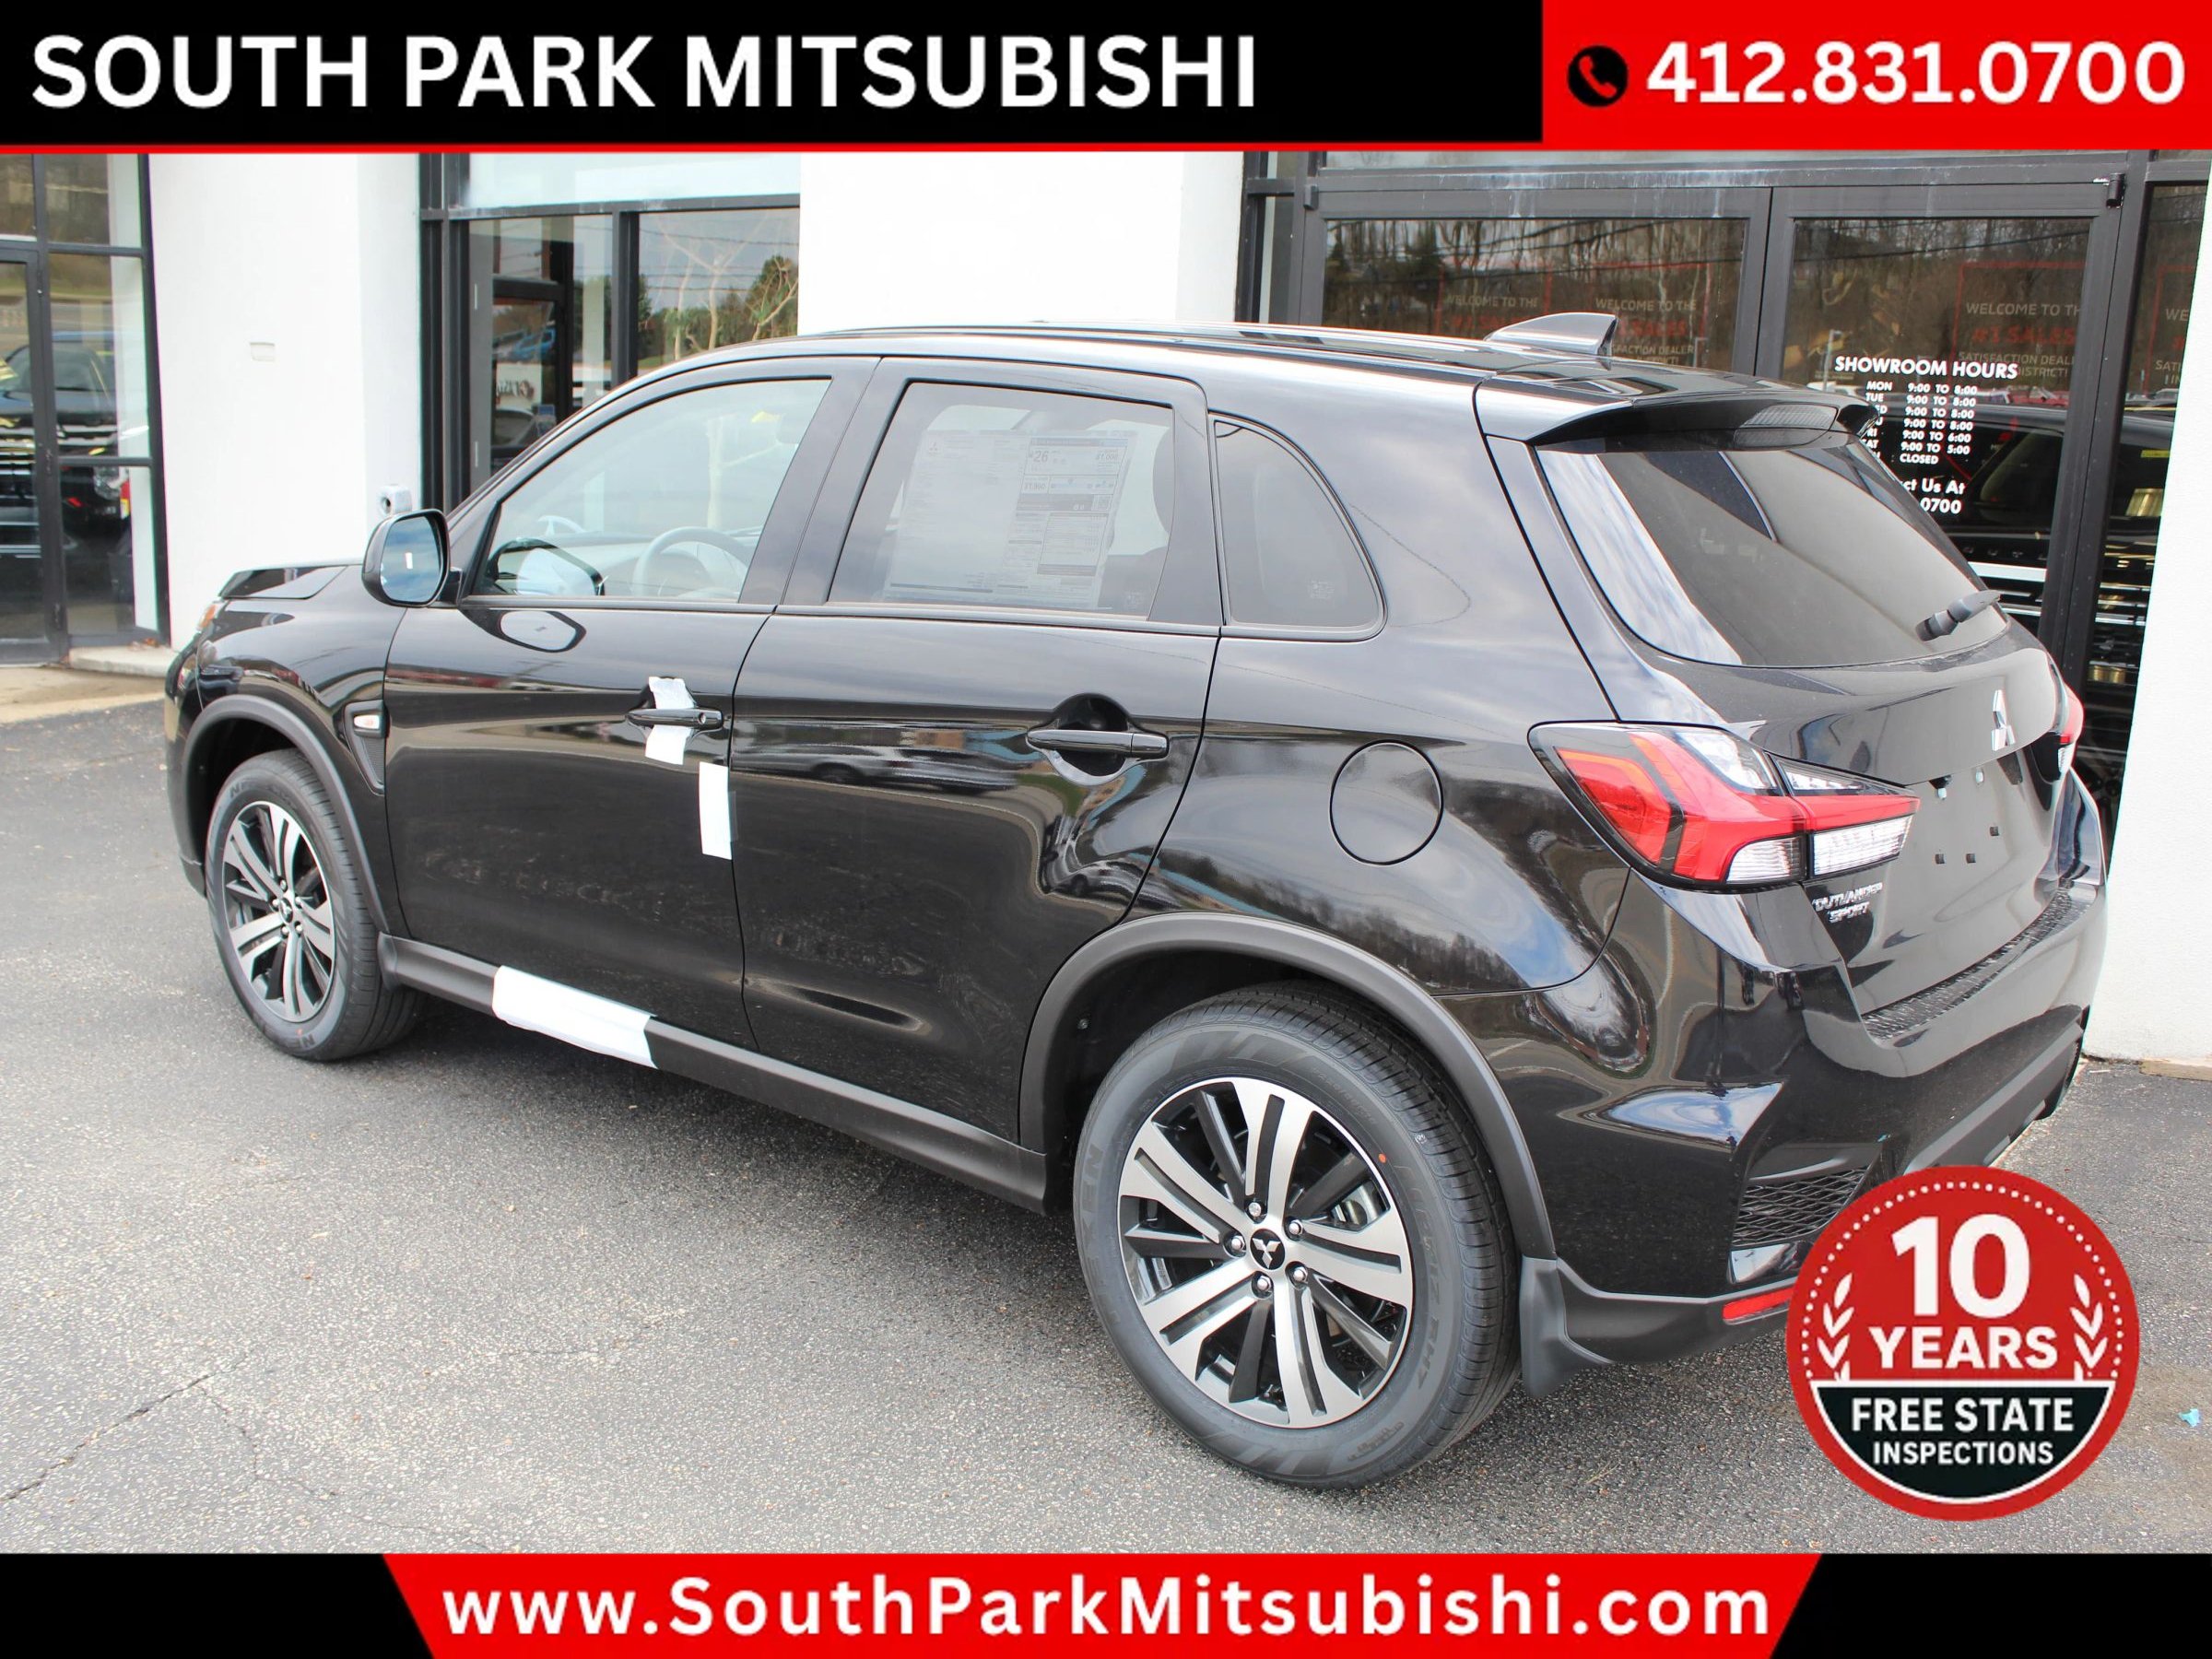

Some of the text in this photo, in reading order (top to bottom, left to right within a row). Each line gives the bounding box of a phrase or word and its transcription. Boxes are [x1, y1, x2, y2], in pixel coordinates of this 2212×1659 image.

[1502, 297, 1516, 307] TO
[1595, 298, 1697, 311] WELCOME TO THE
[1966, 303, 2081, 317] WELCOME TO TH
[1835, 356, 1947, 376] SHOWROOM
[1952, 361, 2018, 379] HOURS
[1866, 381, 1978, 395] MON 9:00 TO 8:00
[1865, 393, 1976, 407] TUE 9:00 TO 8:00
[1905, 406, 1927, 417] 9:00
[1933, 407, 1947, 418] TO
[1951, 409, 1975, 419] 8:00
[1903, 418, 1973, 431] 9:00 TO 8:00
[1902, 429, 1924, 441] 9:00
[1930, 431, 1944, 441] TO
[1947, 432, 1971, 443] 6:00
[1900, 441, 1923, 452] 9:00
[1927, 442, 1941, 453] TO
[1947, 444, 1971, 454] 5:00
[1900, 453, 1939, 465] CLOSED
[1922, 478, 1941, 493] Us
[1946, 480, 1966, 495] At
[1827, 901, 1871, 924] SPORT
